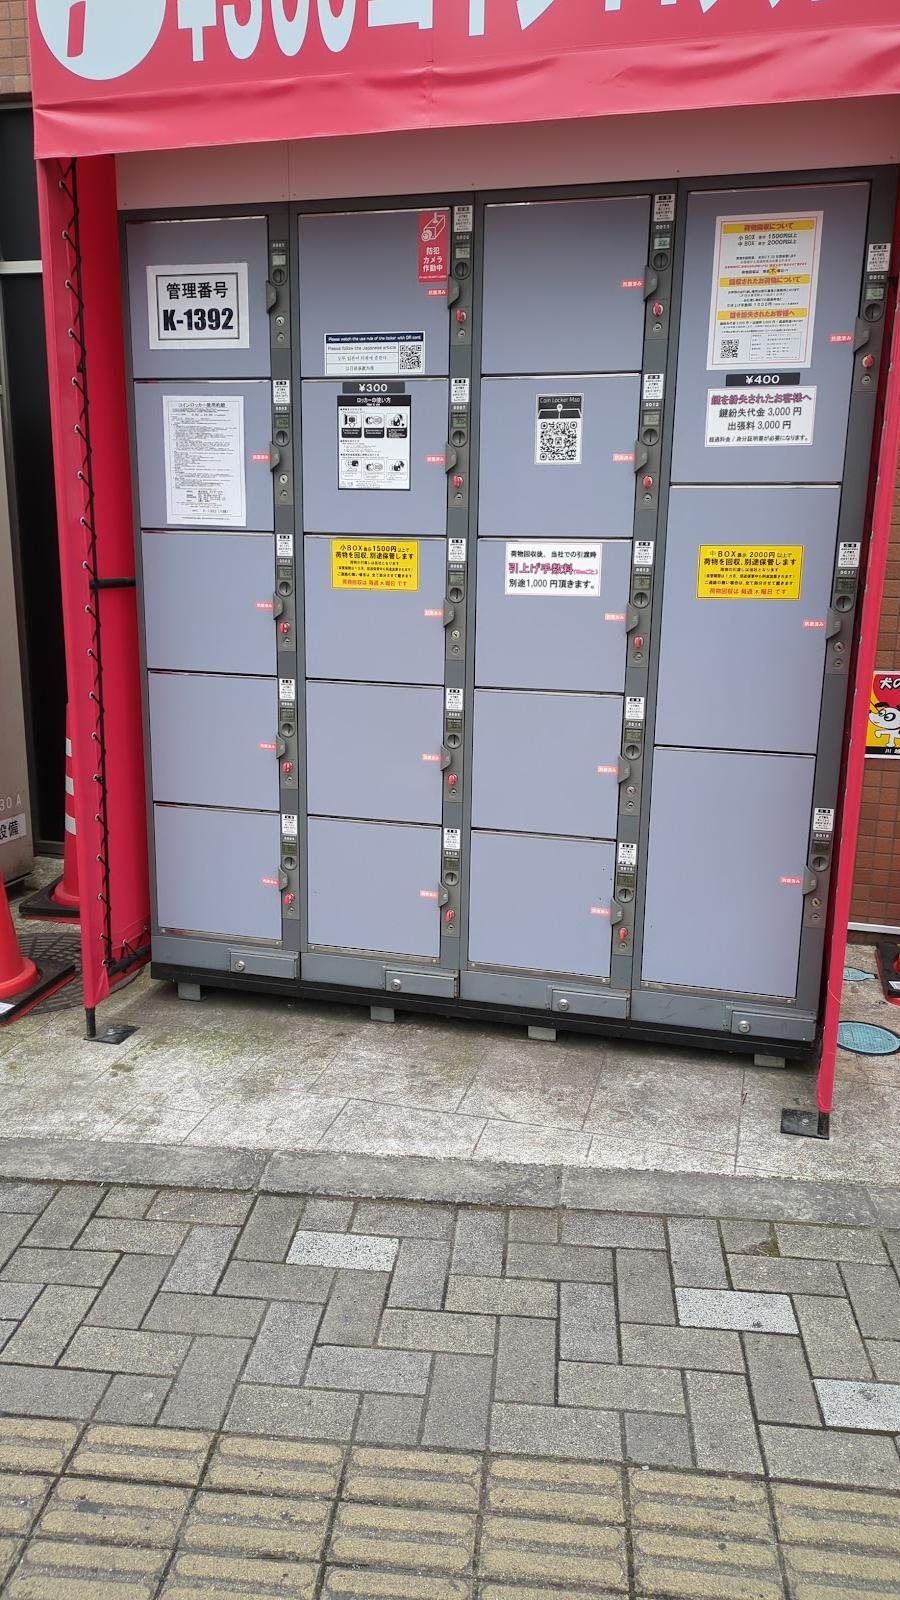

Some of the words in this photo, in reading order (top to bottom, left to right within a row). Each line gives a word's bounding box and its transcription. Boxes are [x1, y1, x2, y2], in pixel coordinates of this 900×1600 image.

[426, 246, 440, 256] 防犯
[424, 256, 442, 264] カメラ
[422, 264, 443, 272] 作動中
[166, 282, 228, 300] 管理番号
[162, 308, 234, 331] K-1392
[746, 374, 780, 384] ¥400
[358, 383, 388, 392] ¥300
[356, 396, 391, 404] ロッカーの使い方
[570, 396, 580, 404] Map
[719, 408, 766, 418] 鍵紛失代金
[768, 406, 790, 416] 3,000
[792, 406, 802, 416] 円
[728, 421, 755, 431] 出張料
[758, 420, 780, 430] 3,000
[782, 420, 792, 430] 円
[508, 579, 548, 588] 別途1,000
[550, 580, 595, 589] 円頂きます。
